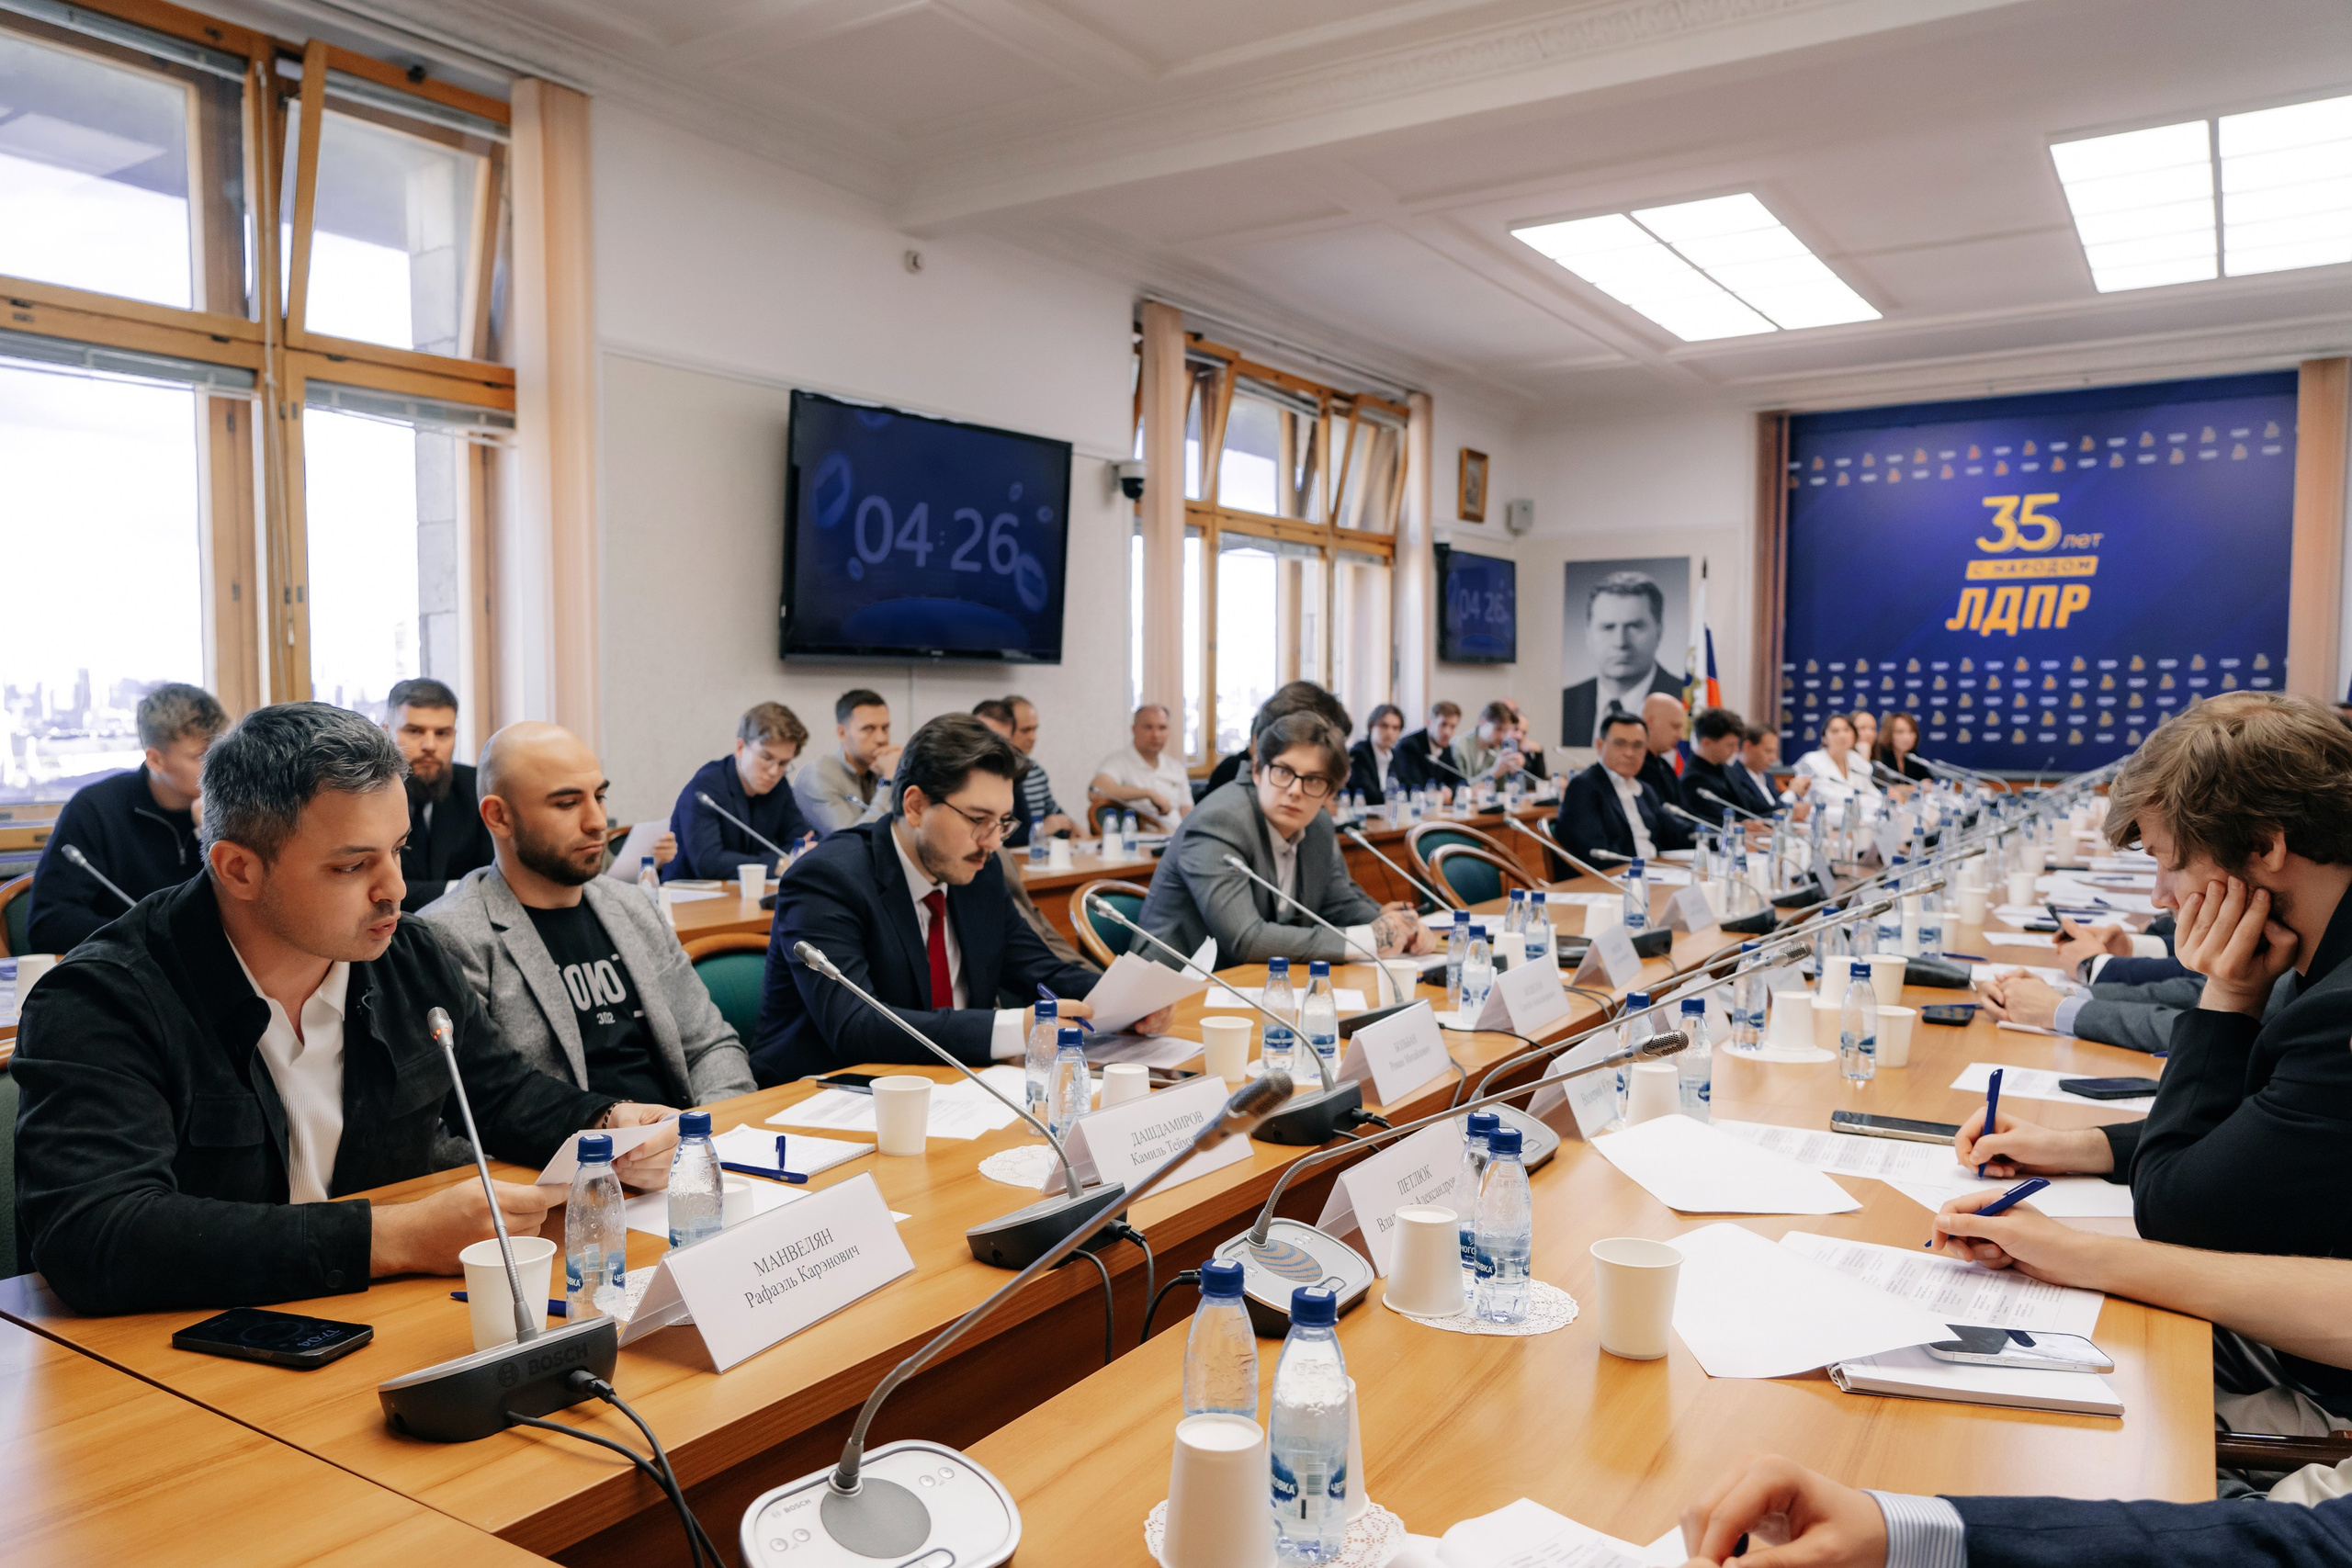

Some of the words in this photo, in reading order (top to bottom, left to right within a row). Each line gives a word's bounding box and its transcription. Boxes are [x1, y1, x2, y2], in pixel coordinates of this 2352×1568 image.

[854, 494, 1021, 575] 04:26
[1975, 492, 2063, 553] 35
[2061, 532, 2104, 549] лет
[1458, 588, 1506, 624] 0426
[1944, 583, 2092, 637] ЛДПР
[1130, 1111, 1204, 1146] ДАШДАМИРОВ
[1130, 1147, 1167, 1166] Камиль
[1165, 1134, 1197, 1154] Тейму
[1396, 1164, 1433, 1196] ПЕТЛЮК
[752, 1228, 834, 1277] МАНВЕЛЯН
[744, 1276, 798, 1308] Рафаэль
[797, 1246, 861, 1283] Карэнович
[527, 1342, 589, 1376] BOSCH
[784, 1498, 812, 1513] BOSCH
